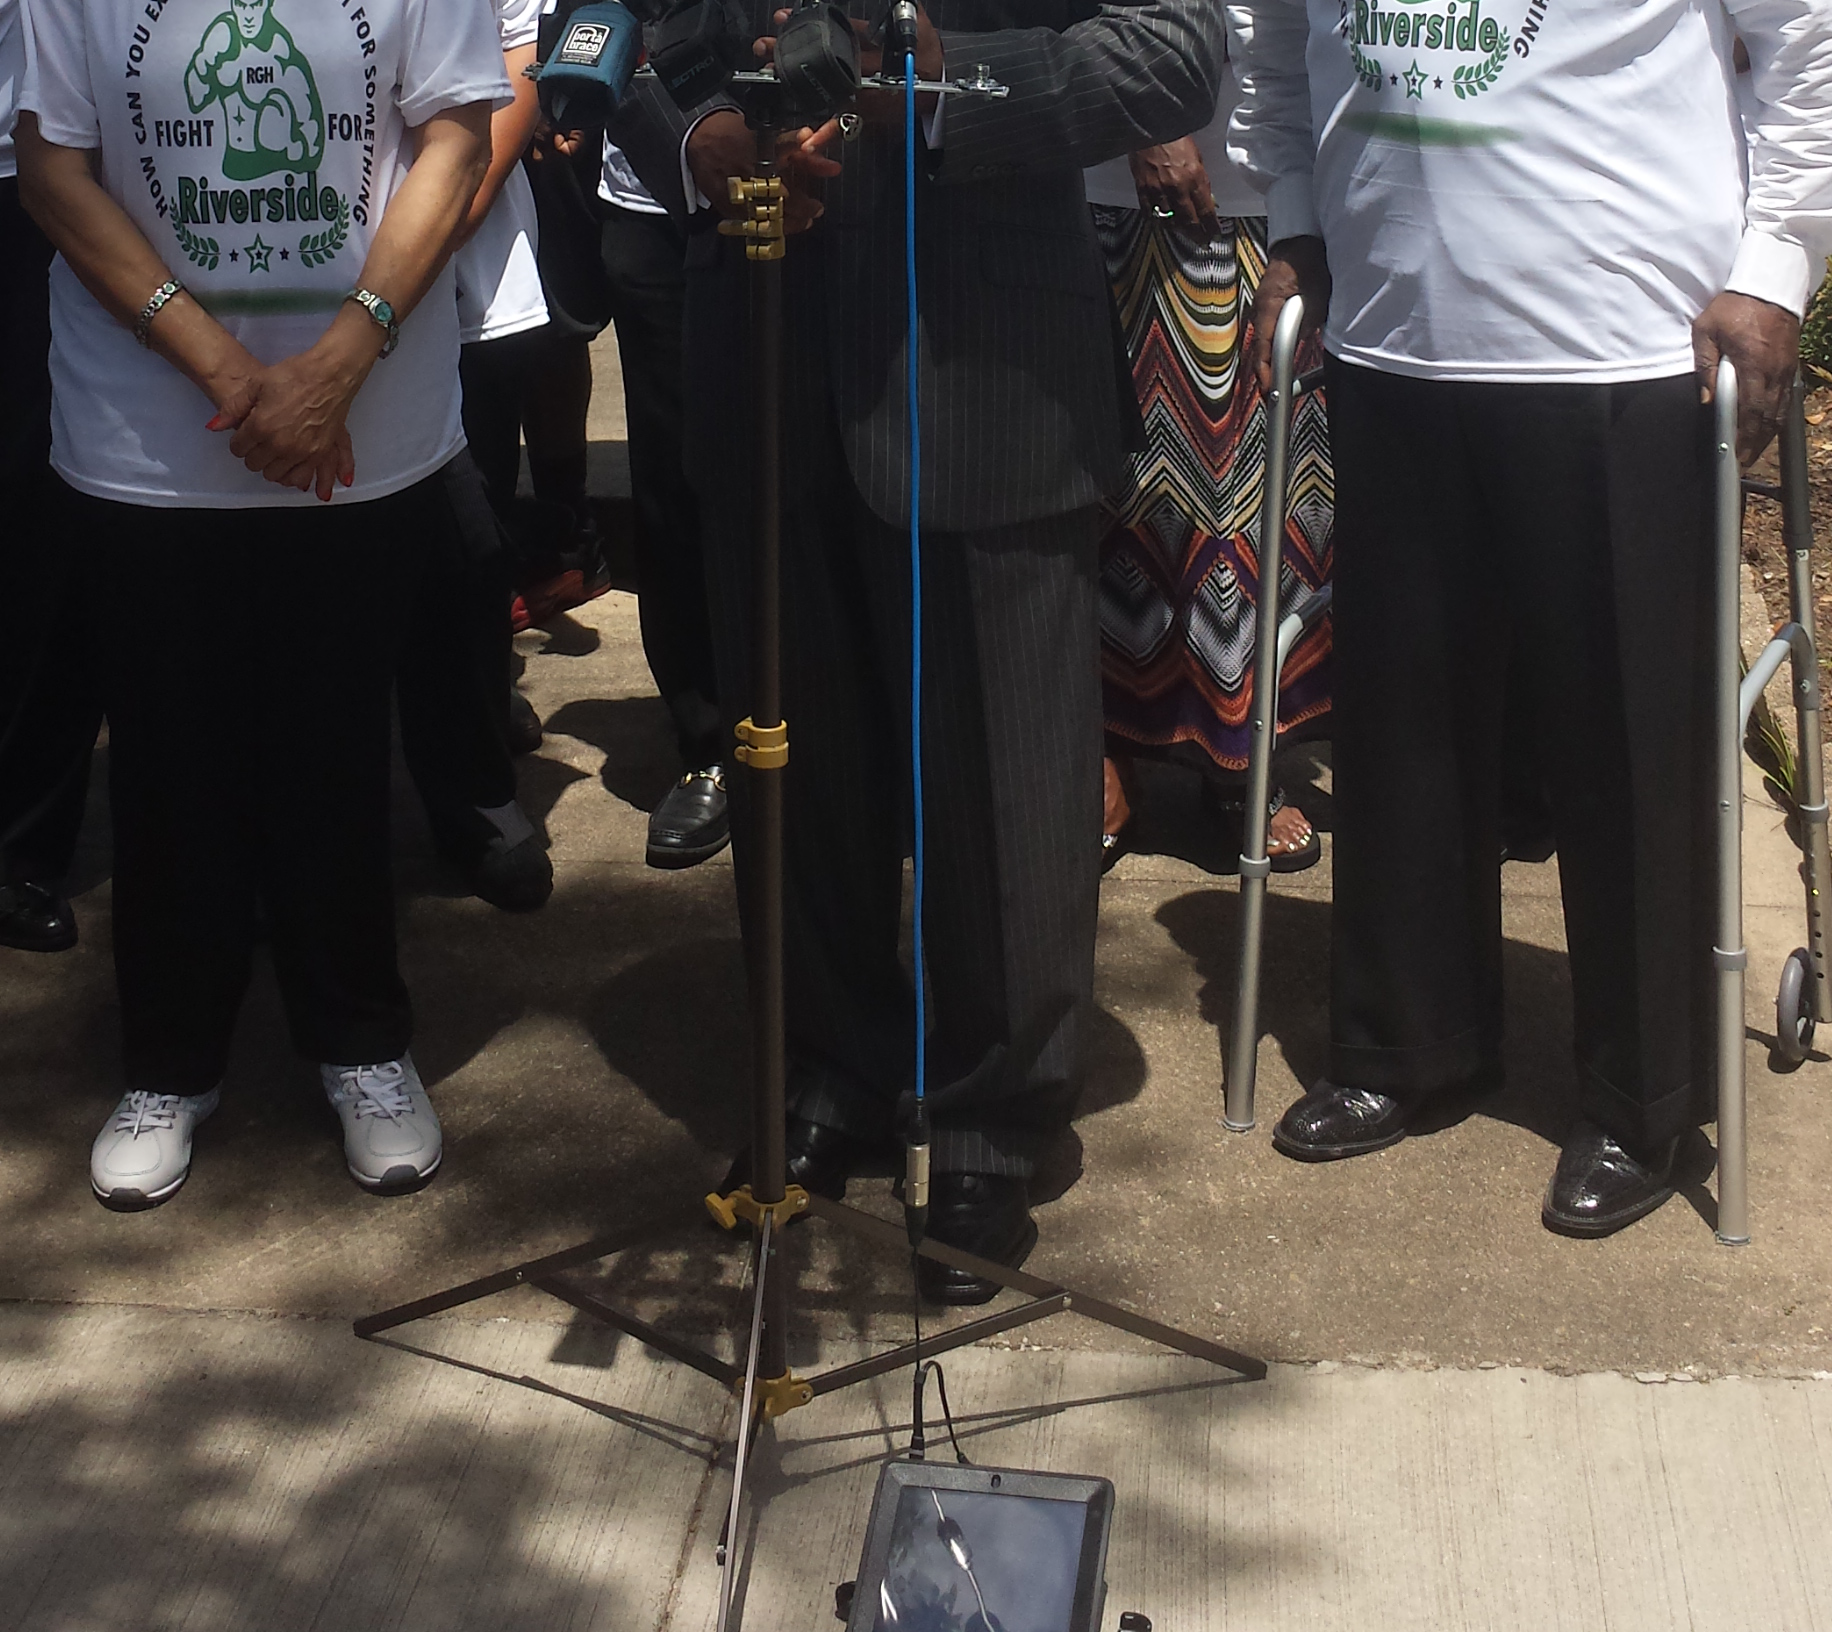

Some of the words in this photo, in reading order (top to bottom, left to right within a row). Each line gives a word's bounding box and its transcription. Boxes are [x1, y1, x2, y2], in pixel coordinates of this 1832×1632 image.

[125, 23, 152, 81] YOU
[350, 6, 377, 60] FOR
[246, 66, 274, 85] RGH
[127, 91, 148, 145] CAN
[155, 119, 215, 148] FIGHT
[328, 112, 364, 142] FOR
[353, 66, 378, 228] SOMETHING
[140, 155, 168, 219] HOW
[178, 169, 339, 225] Riverside
